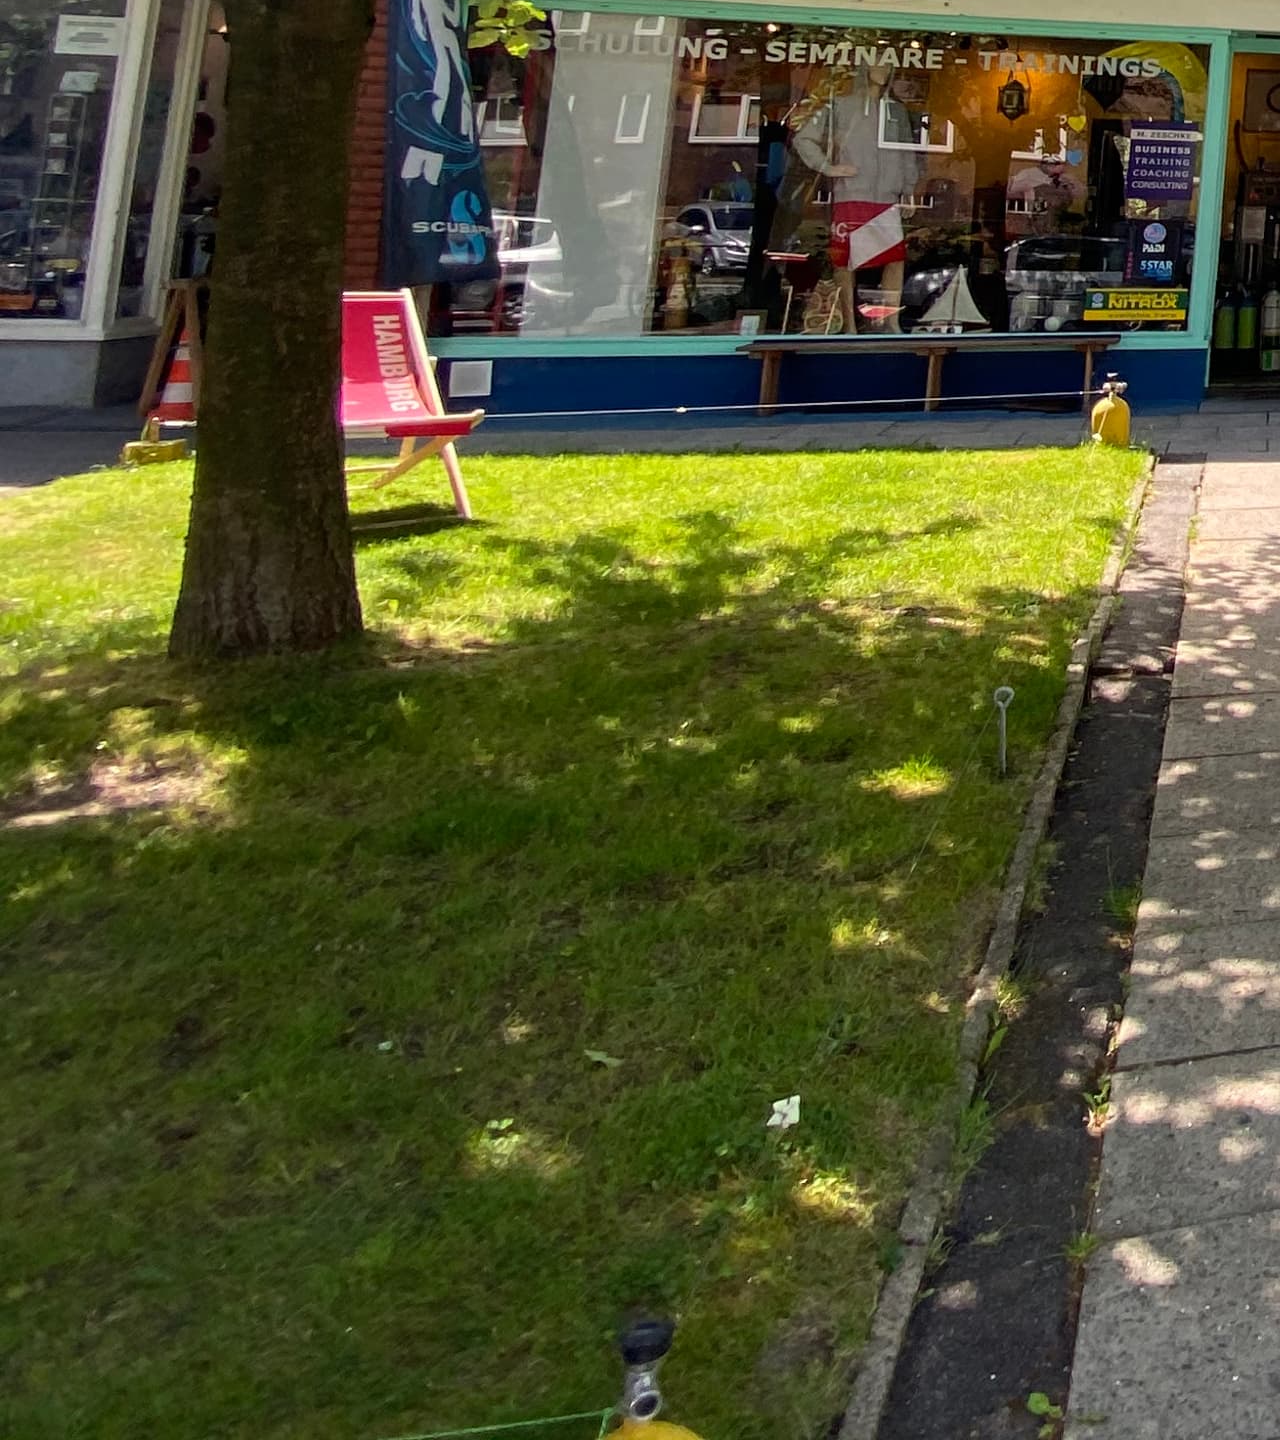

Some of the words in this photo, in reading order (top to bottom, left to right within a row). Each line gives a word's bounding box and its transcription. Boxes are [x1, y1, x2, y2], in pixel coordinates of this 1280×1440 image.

[531, 28, 729, 60] SCHULUNG
[764, 39, 944, 70] SEMINARE
[978, 51, 1162, 78] TRAININGS
[1134, 145, 1191, 155] BUSINESS
[1135, 157, 1190, 166] TRAINING
[1132, 169, 1189, 178] COACHING
[1131, 180, 1188, 190] CONSULTING
[1142, 243, 1165, 253] PADI
[1108, 298, 1177, 309] NITROX
[372, 314, 419, 412] HAMBURG
